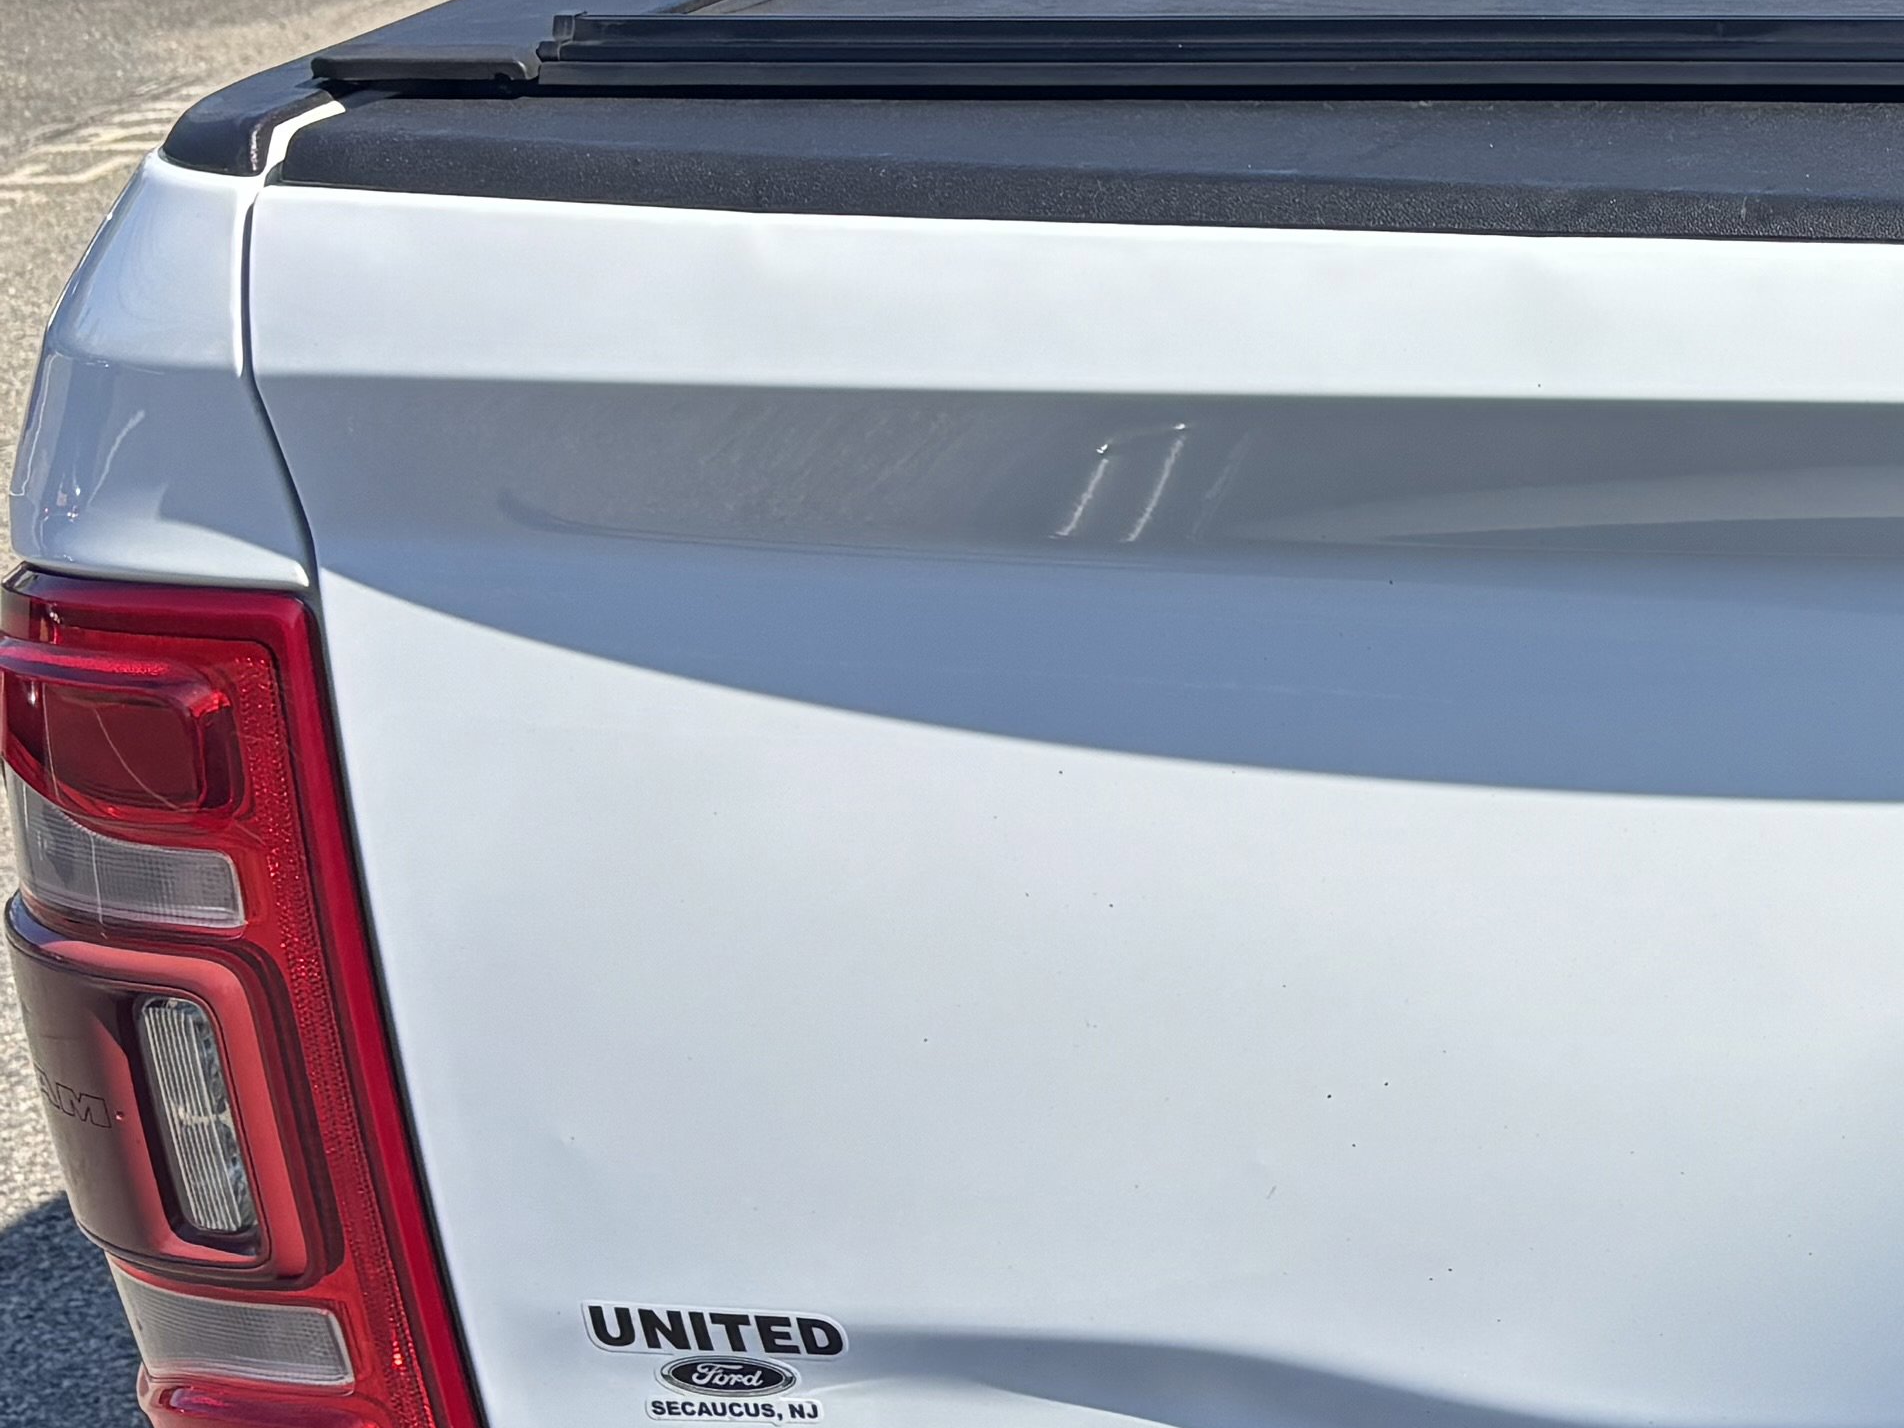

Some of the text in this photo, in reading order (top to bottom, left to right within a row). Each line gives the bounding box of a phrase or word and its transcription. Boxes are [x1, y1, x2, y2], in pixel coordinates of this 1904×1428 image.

[588, 1305, 844, 1356] UNITED
[692, 1362, 764, 1388] Ford
[651, 1400, 819, 1421] SECAUCUS, NJ
